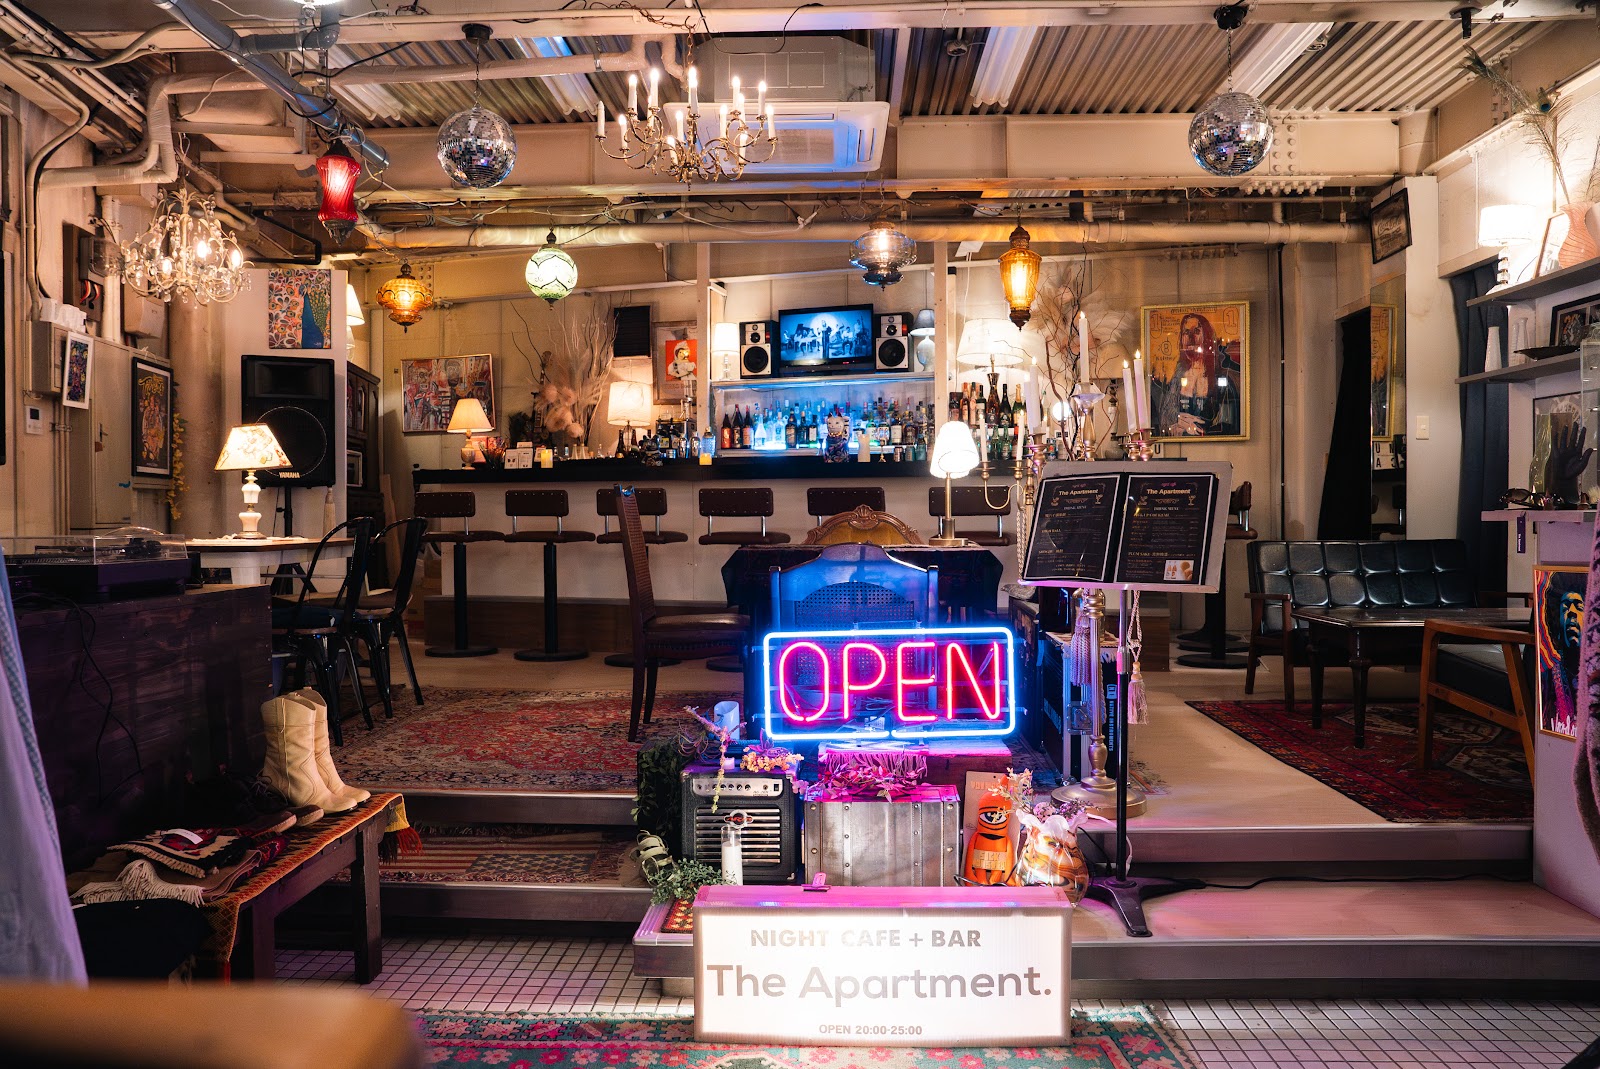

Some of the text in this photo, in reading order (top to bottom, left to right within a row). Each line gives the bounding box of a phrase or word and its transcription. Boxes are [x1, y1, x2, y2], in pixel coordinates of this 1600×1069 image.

[778, 641, 1001, 722] OPEN
[751, 929, 981, 948] NIGHT CAFE + BAR
[706, 964, 1052, 1008] The Apartment.
[818, 1023, 923, 1036] OPEN 20:00-25:00
